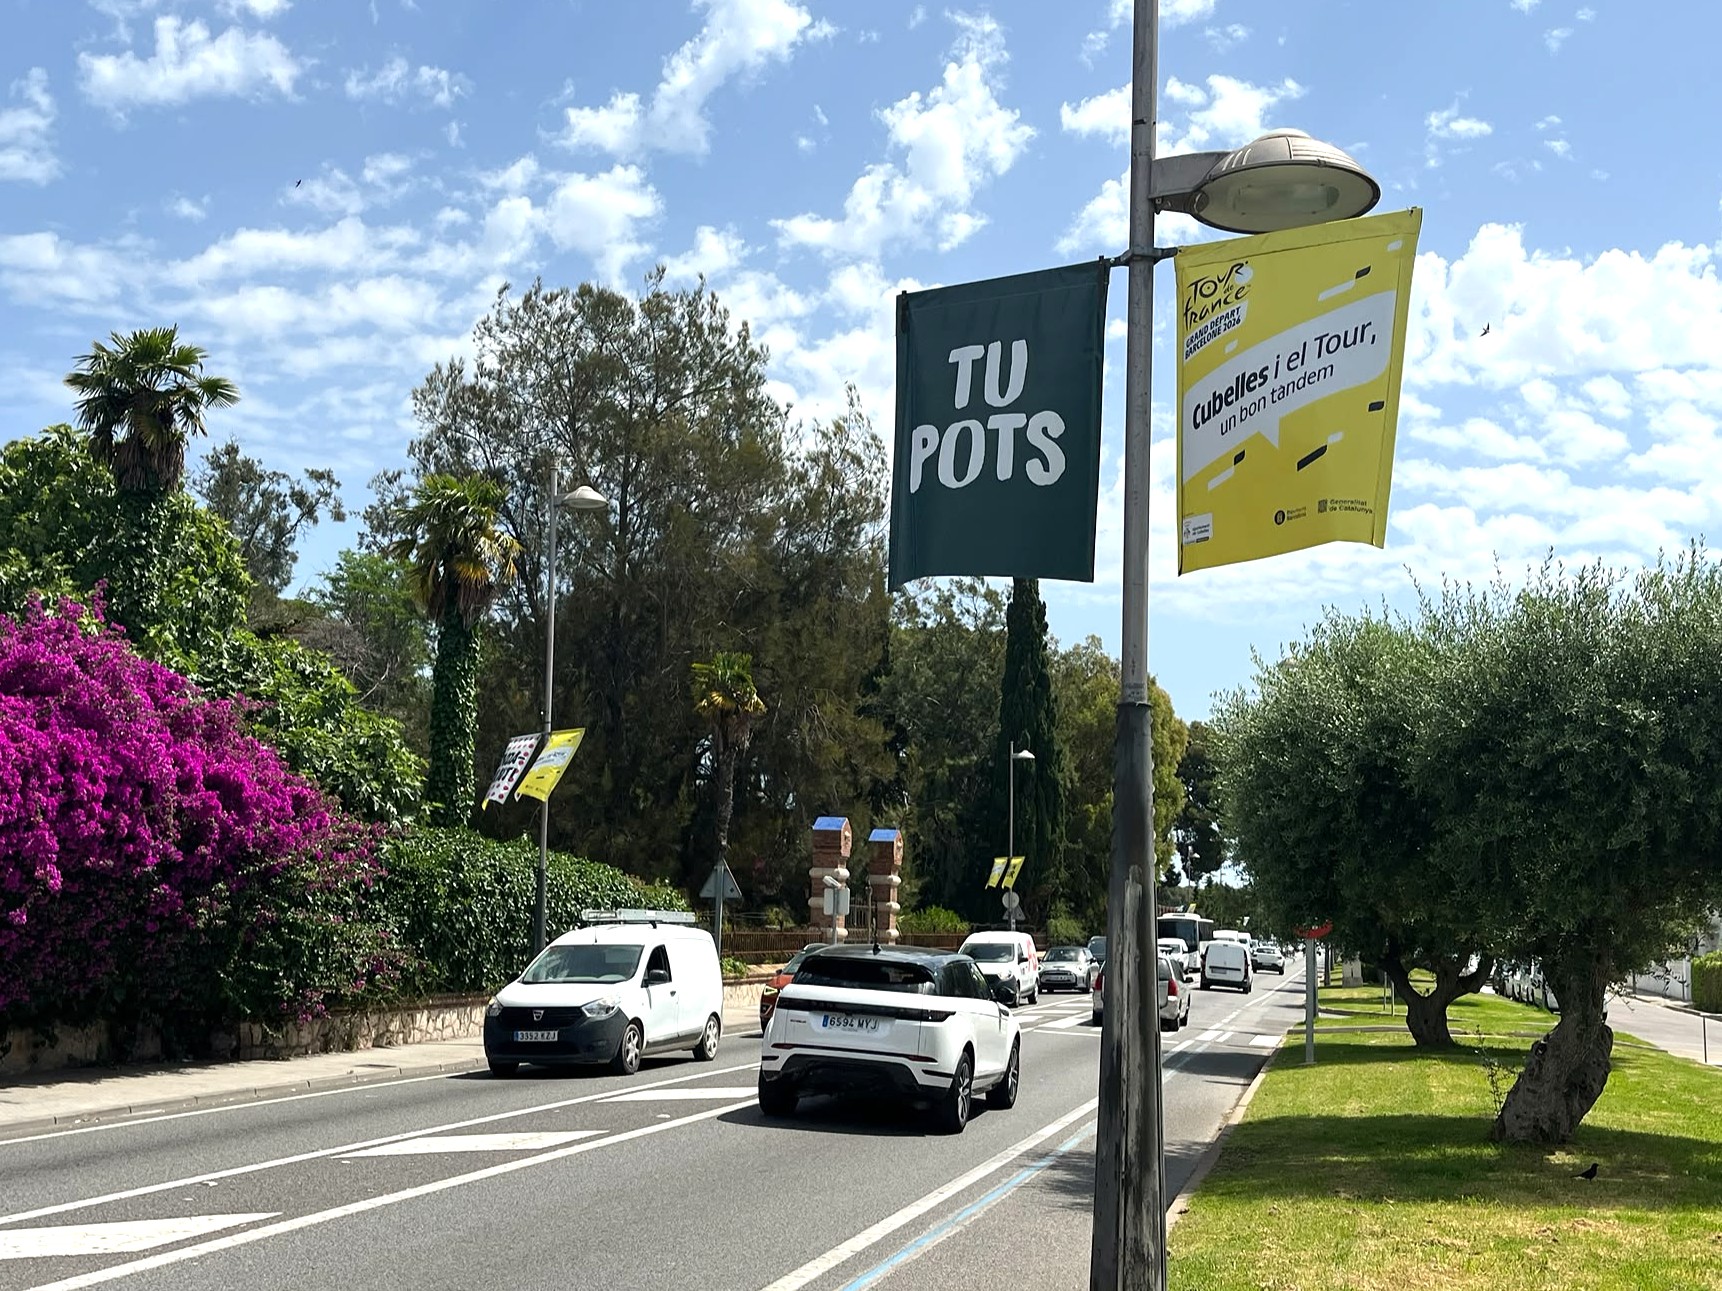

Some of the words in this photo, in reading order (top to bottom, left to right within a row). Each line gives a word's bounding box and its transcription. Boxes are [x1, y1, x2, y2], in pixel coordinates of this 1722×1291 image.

[1185, 325, 1209, 348] GRAND
[1210, 306, 1242, 330] DÉPART
[1185, 326, 1222, 360] BARCELONE
[1223, 315, 1242, 332] 2026
[949, 339, 1028, 409] TU
[1193, 365, 1269, 430] Cubelles
[1274, 354, 1280, 380] i
[1286, 341, 1307, 372] el
[1314, 321, 1376, 359] Tour,
[1221, 414, 1237, 436] un
[1240, 395, 1266, 423] bon
[1270, 363, 1334, 404] tàndem
[909, 411, 1066, 493] POTS
[829, 1016, 855, 1028] 6594
[857, 1018, 878, 1030] MYJ
